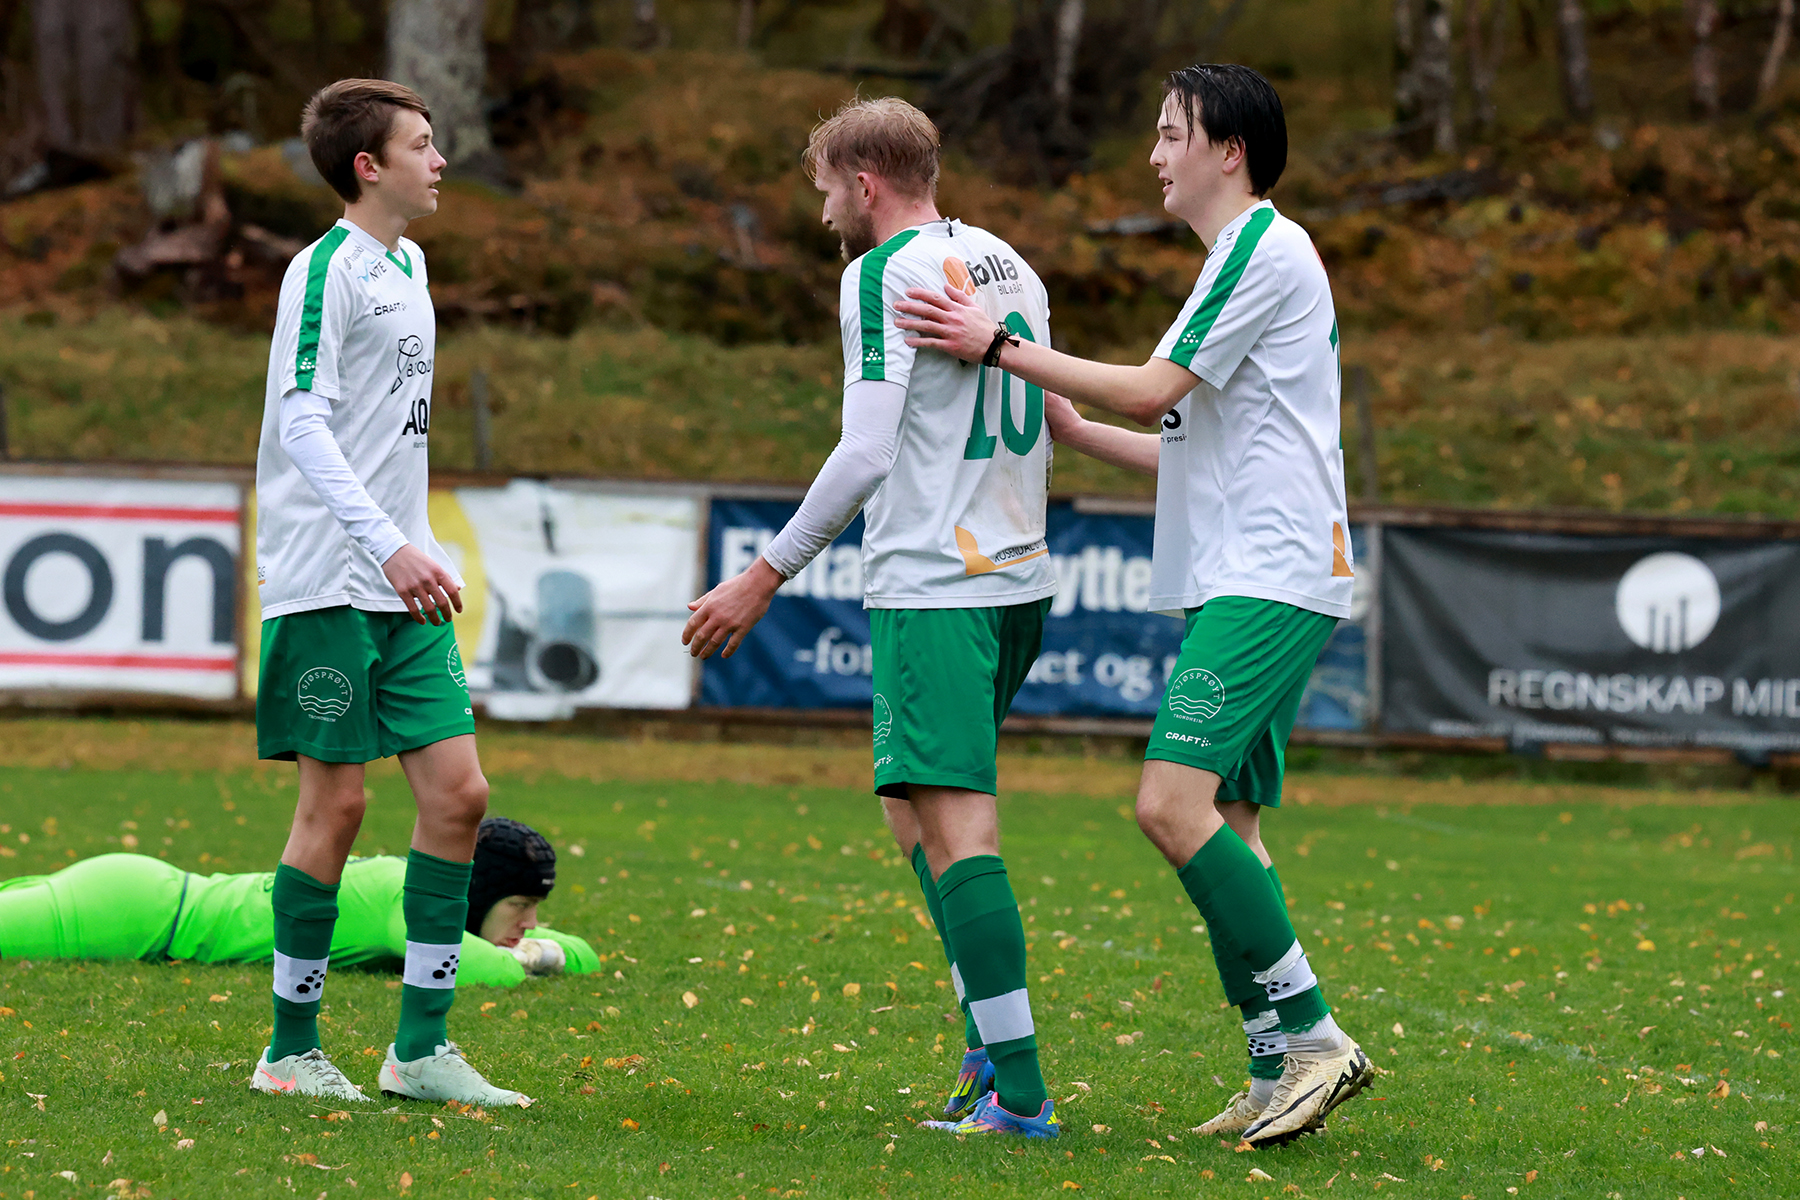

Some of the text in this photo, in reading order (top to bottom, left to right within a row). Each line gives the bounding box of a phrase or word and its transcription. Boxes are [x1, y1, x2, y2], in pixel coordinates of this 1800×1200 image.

[369, 261, 387, 282] NTE
[997, 284, 1010, 295] BIL
[374, 302, 402, 316] CRAFT
[963, 311, 1045, 461] 10
[4, 530, 236, 642] on
[301, 671, 348, 696] SJØSPRØYT
[1175, 672, 1220, 700] SJØSPRØYT
[1487, 666, 1726, 715] REGNSKAP
[1173, 713, 1204, 724] TRONDHEIM
[1165, 731, 1202, 745] CRAFT
